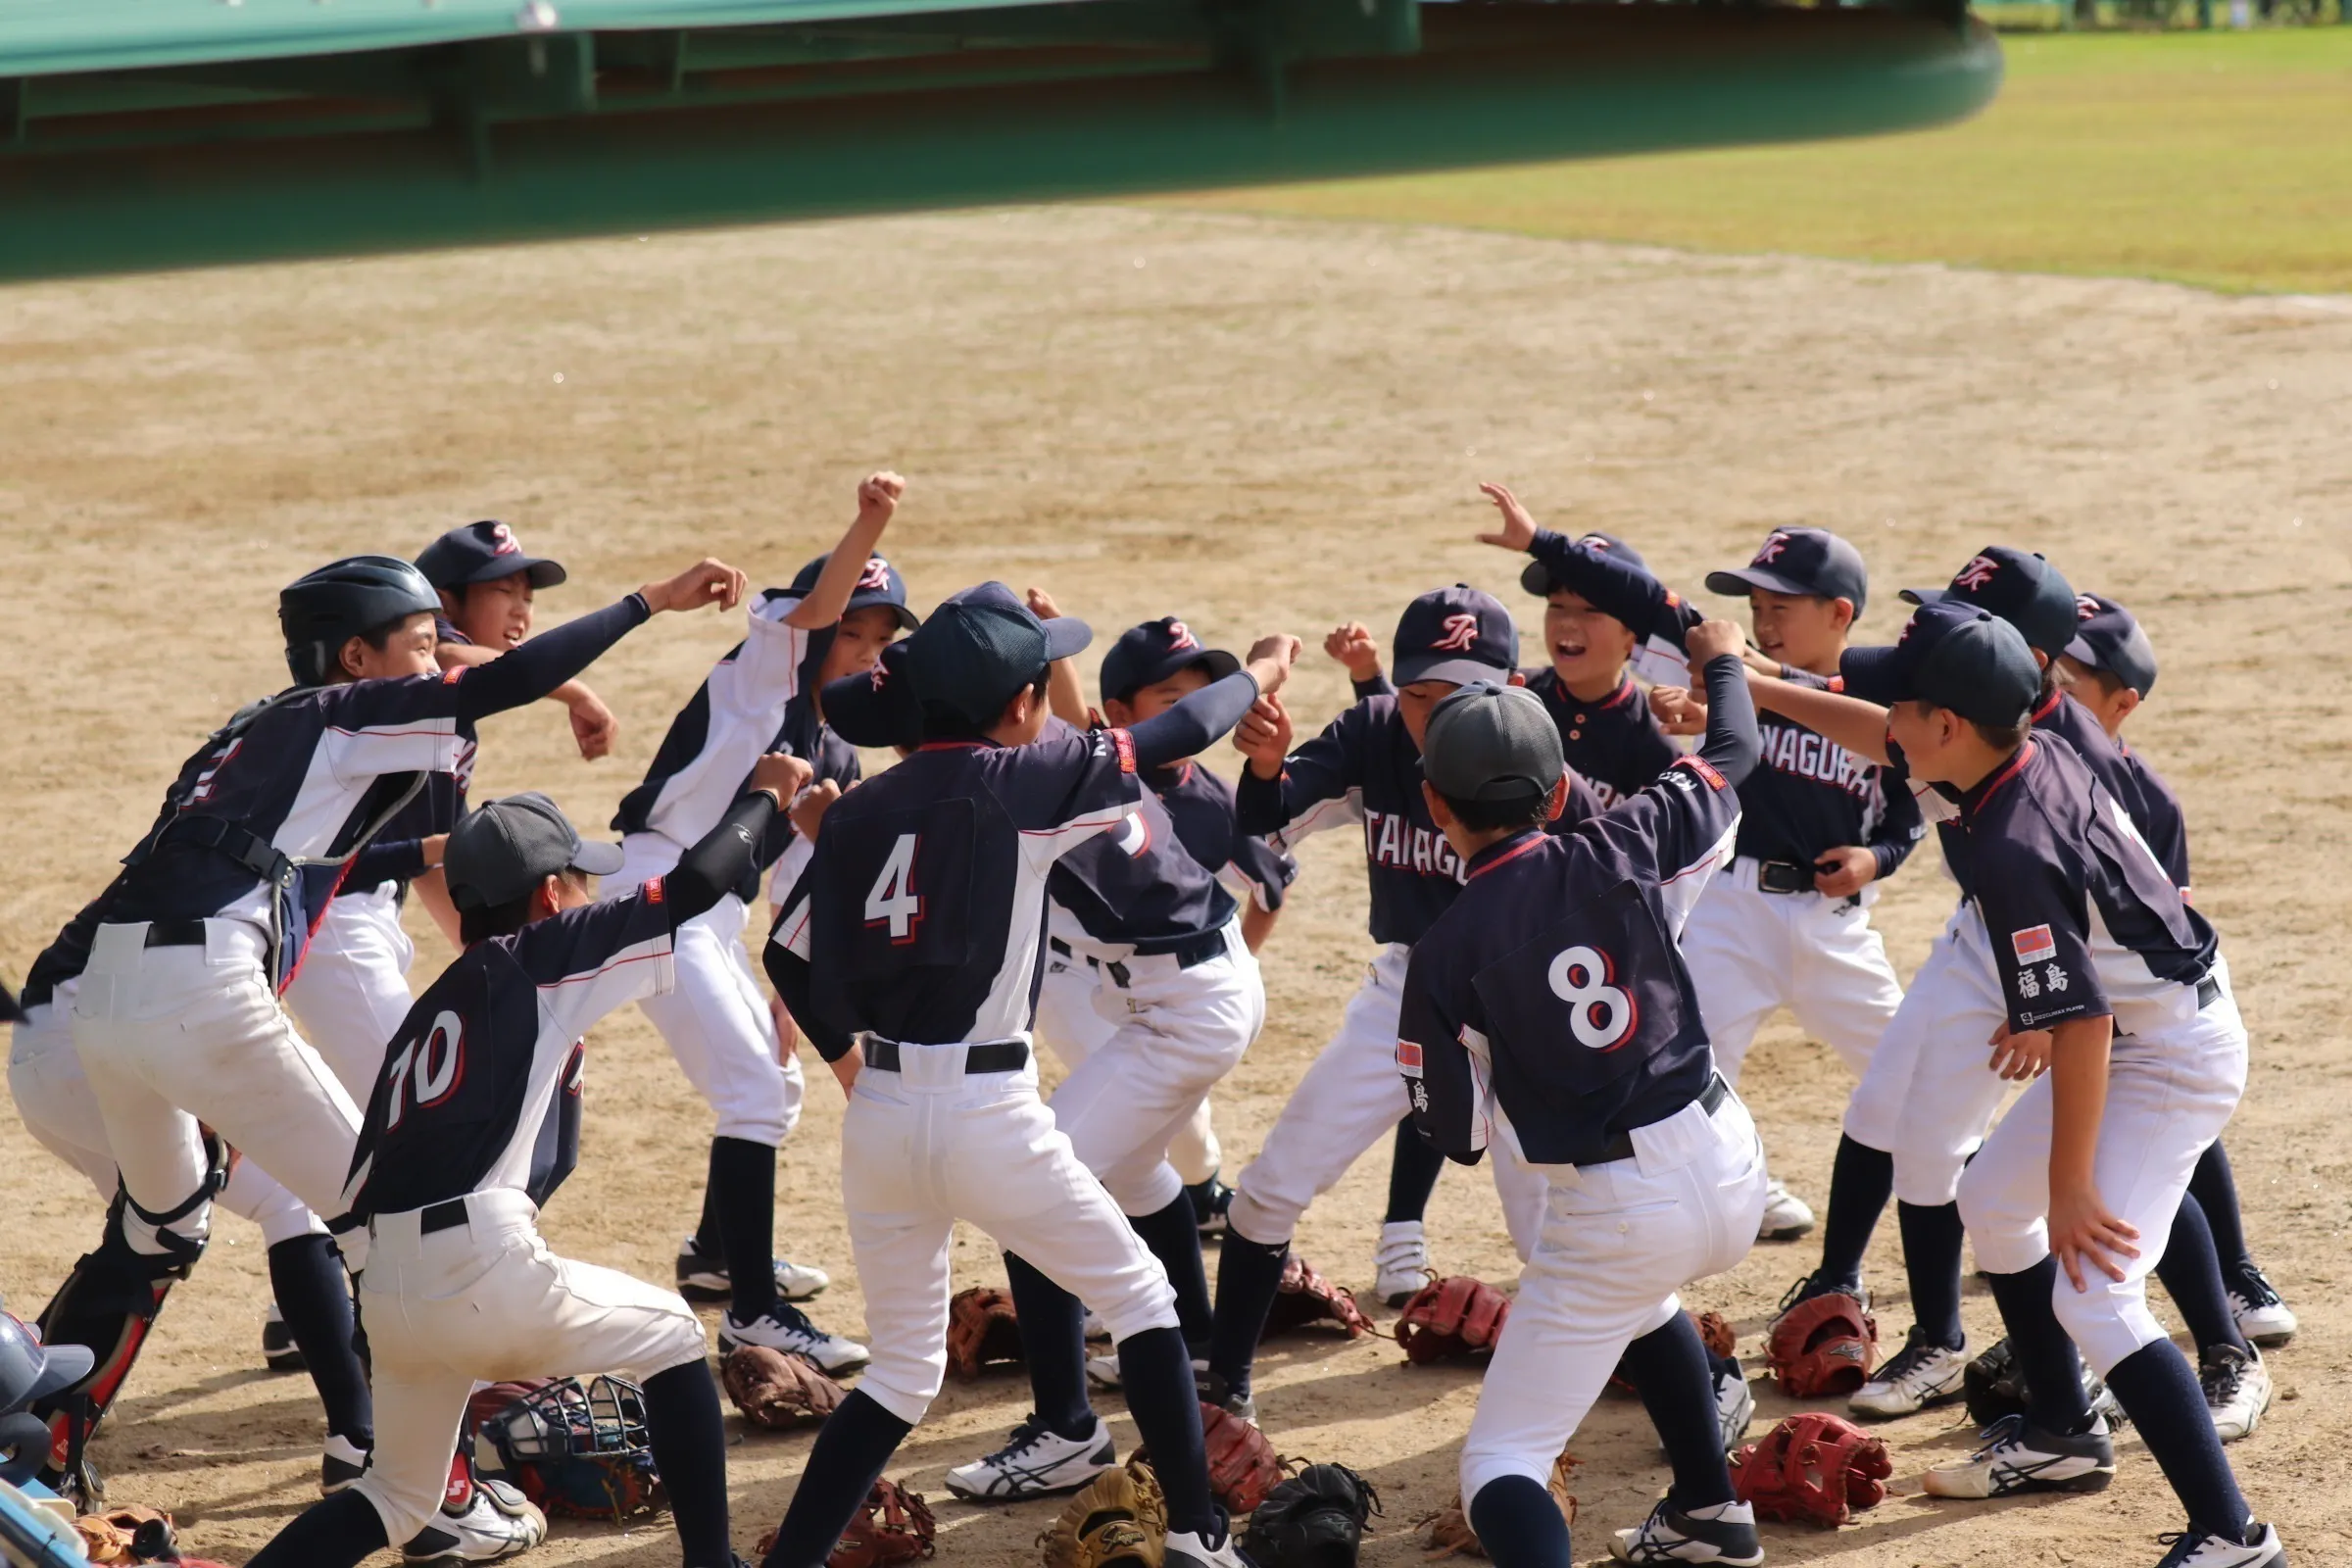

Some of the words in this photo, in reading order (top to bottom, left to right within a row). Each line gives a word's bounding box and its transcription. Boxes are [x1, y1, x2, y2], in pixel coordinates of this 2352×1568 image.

[863, 833, 924, 945] 4
[1548, 945, 1638, 1053] 8
[2018, 963, 2068, 999] 福島
[386, 1009, 465, 1132] 10
[1405, 1079, 1429, 1113] 島
